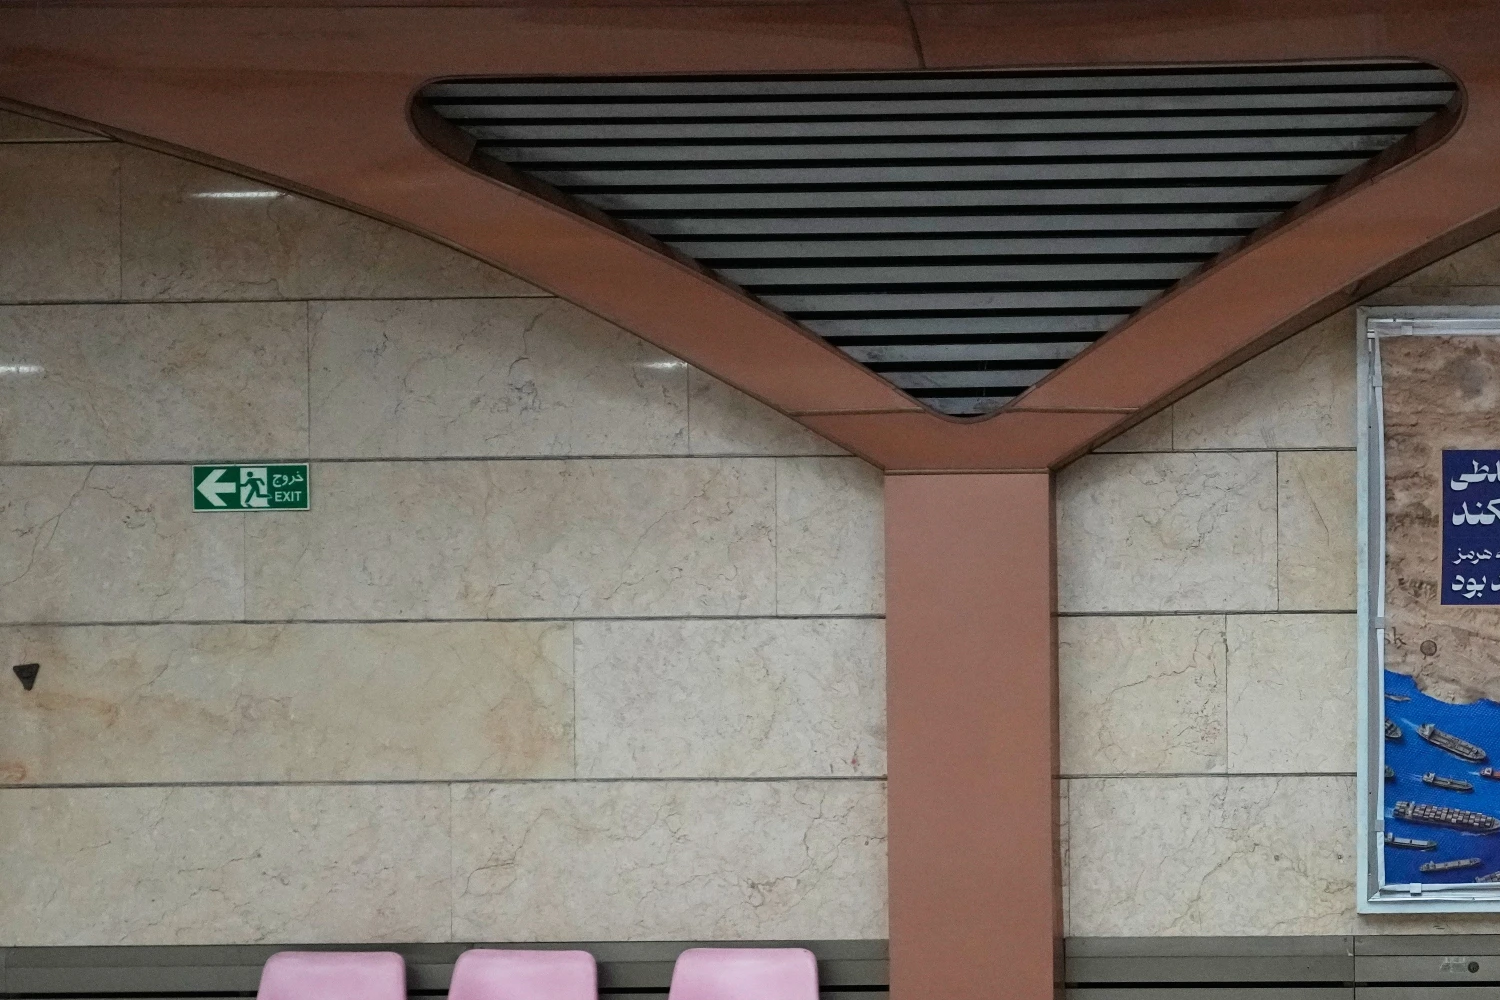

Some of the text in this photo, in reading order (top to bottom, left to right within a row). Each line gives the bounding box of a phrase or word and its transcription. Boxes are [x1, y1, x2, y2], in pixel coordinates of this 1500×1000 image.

[272, 470, 304, 488] خروج
[274, 490, 302, 502] EXIT
[1451, 547, 1493, 564] هرمز
[1451, 574, 1487, 599] بود
